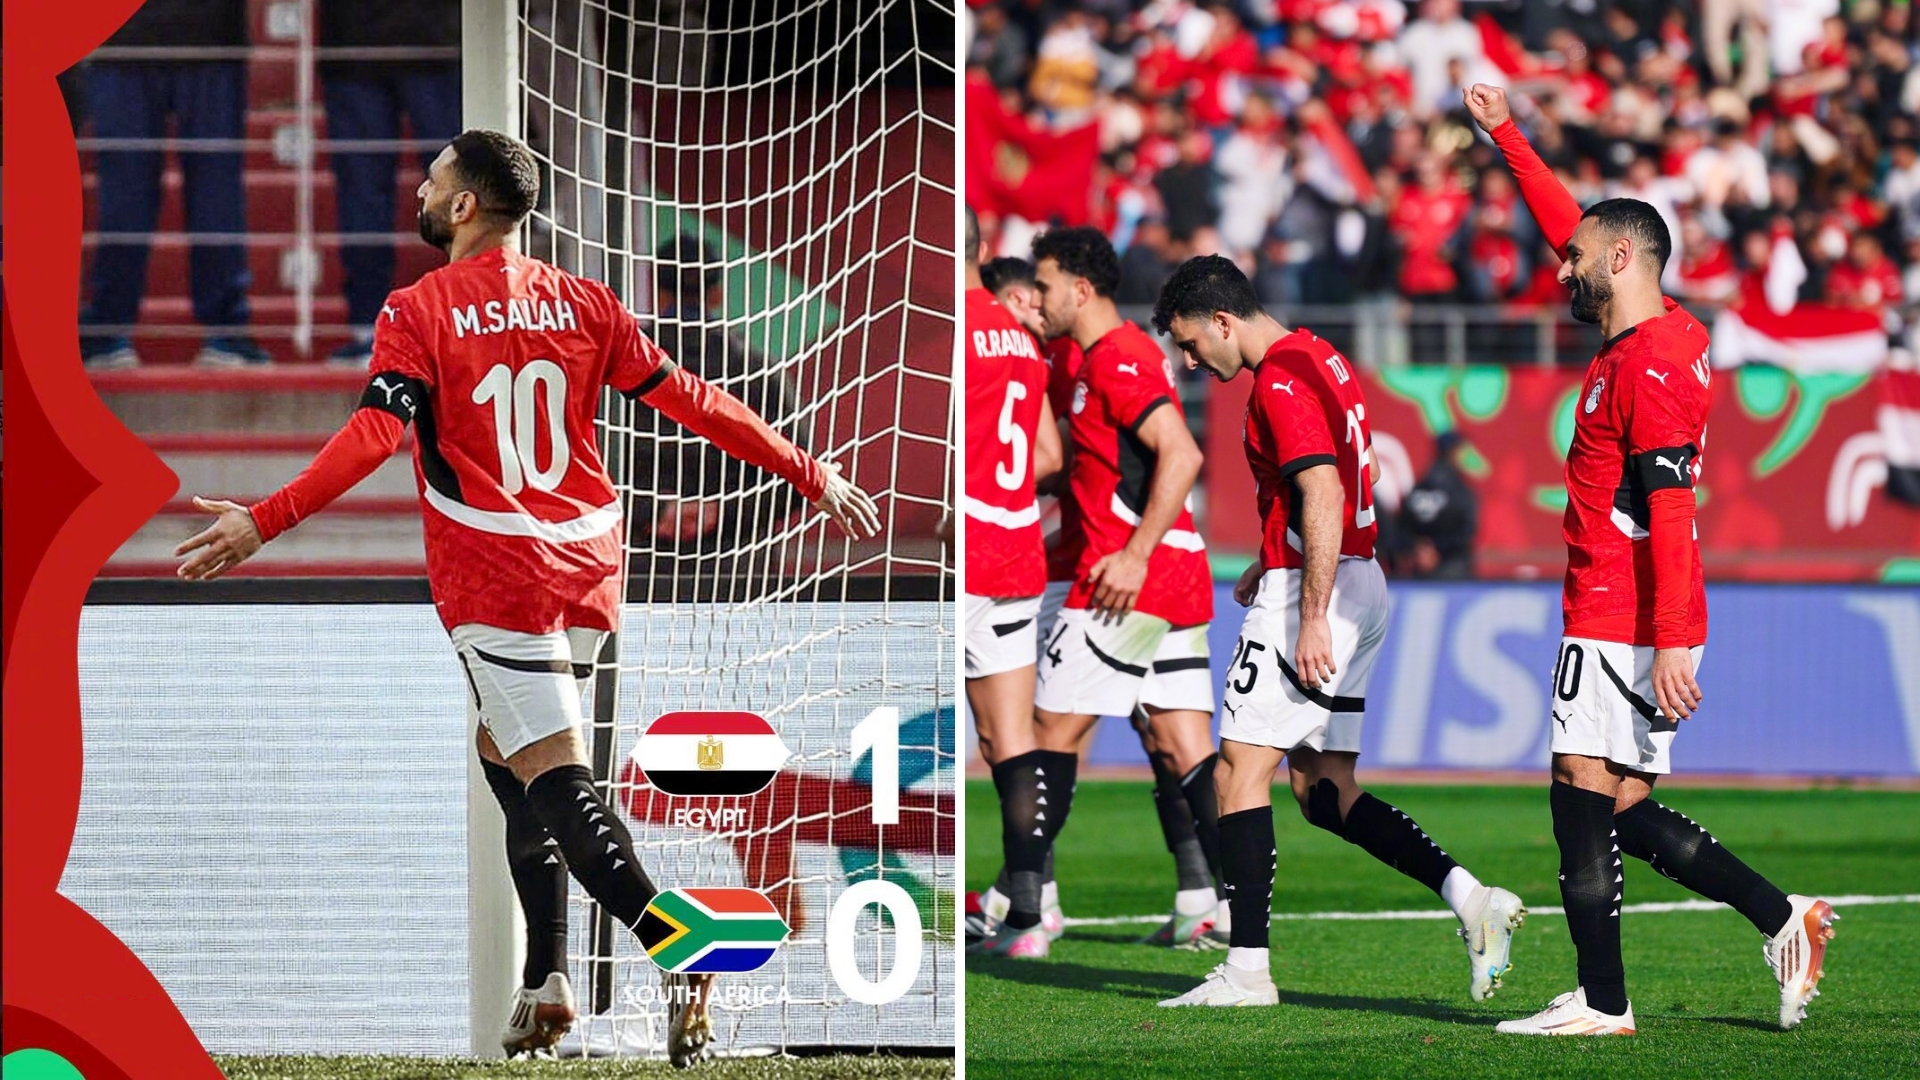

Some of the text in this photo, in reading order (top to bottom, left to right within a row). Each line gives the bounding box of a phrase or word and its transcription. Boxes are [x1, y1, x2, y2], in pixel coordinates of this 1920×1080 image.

[452, 300, 576, 338] M.SALAH
[471, 359, 570, 495] 10
[995, 380, 1029, 491] 5
